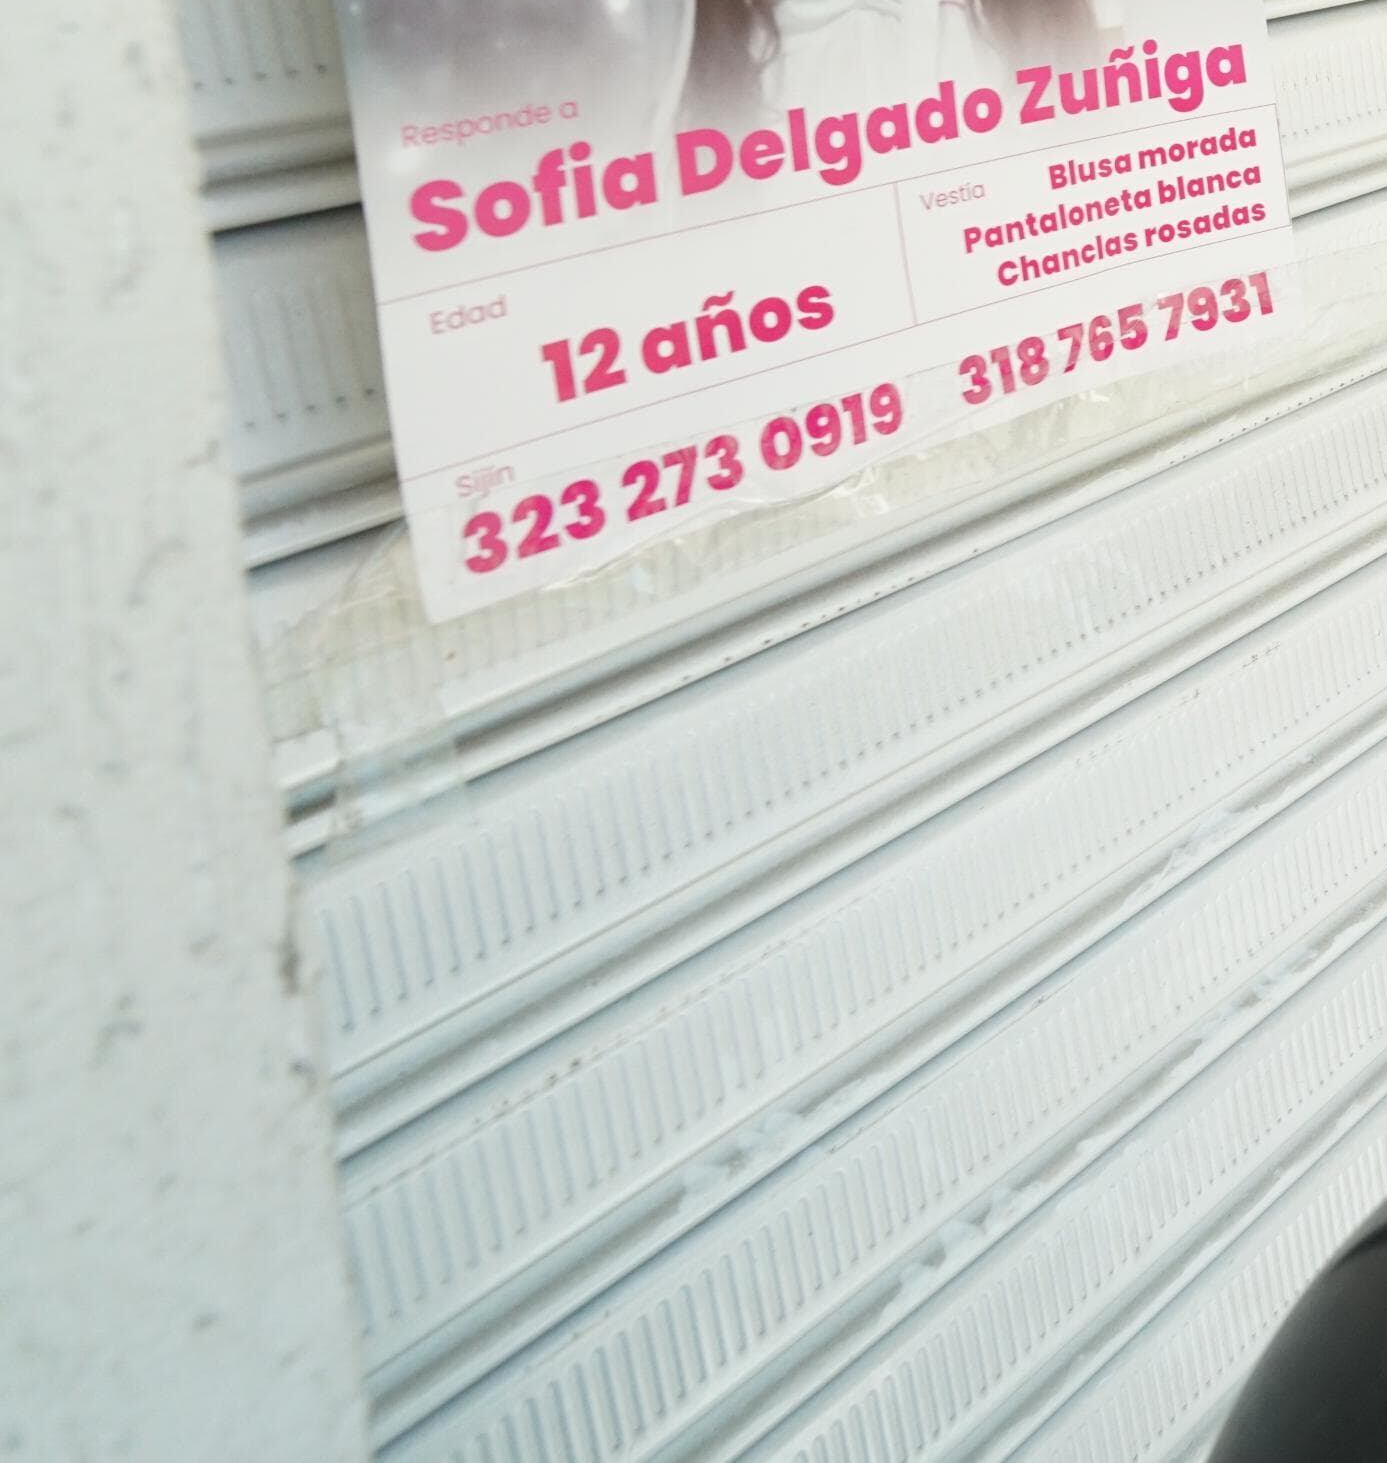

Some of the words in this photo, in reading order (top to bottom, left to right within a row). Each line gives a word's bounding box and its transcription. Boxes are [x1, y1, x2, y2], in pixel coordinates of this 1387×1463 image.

[402, 105, 551, 148] Responde
[559, 101, 578, 119] a
[410, 141, 657, 251] Sofia
[676, 81, 1002, 195] Delgado
[1016, 39, 1247, 125] Zuñiga
[1049, 154, 1132, 190] Blusa
[1139, 127, 1257, 169] morada
[963, 189, 1152, 254] Pantaloneta
[1158, 167, 1262, 205] blanca
[997, 233, 1138, 287] Chanclas
[1145, 204, 1266, 248] rosadas
[430, 294, 507, 334] Edad
[541, 327, 627, 402] 12
[641, 286, 835, 374] años
[959, 337, 1049, 405] 318
[1057, 304, 1149, 373] 765
[1160, 272, 1274, 341] 7931
[463, 479, 607, 574] 323
[621, 435, 745, 522] 273
[761, 383, 903, 471] 0919
